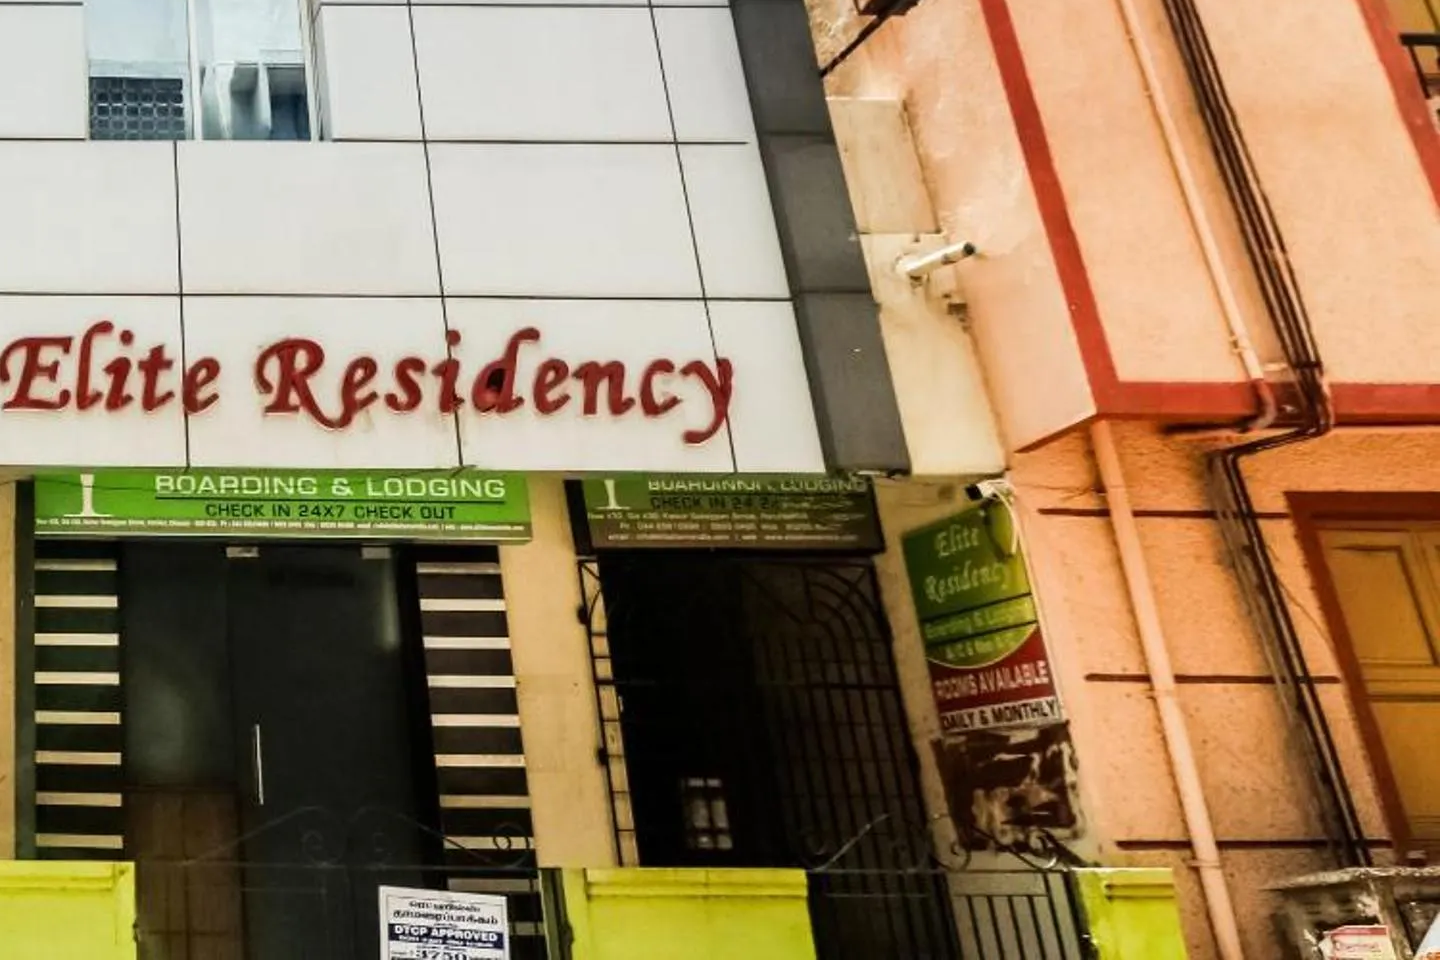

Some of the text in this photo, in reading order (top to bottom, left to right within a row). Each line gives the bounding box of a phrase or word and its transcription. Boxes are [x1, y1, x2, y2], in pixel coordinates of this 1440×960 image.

[257, 327, 735, 445] Residency
[155, 475, 506, 499] BOARDING & LODGING
[205, 503, 456, 520] CHECK IN 24X7 CHECK OUT
[935, 524, 980, 558] Elite
[923, 559, 1009, 603] Residency
[934, 660, 1050, 700] ROOMS AVAILABLE
[942, 699, 1057, 731] DAILY & MONTHLY
[394, 925, 429, 936] DTCP
[431, 928, 498, 942] APPROVED
